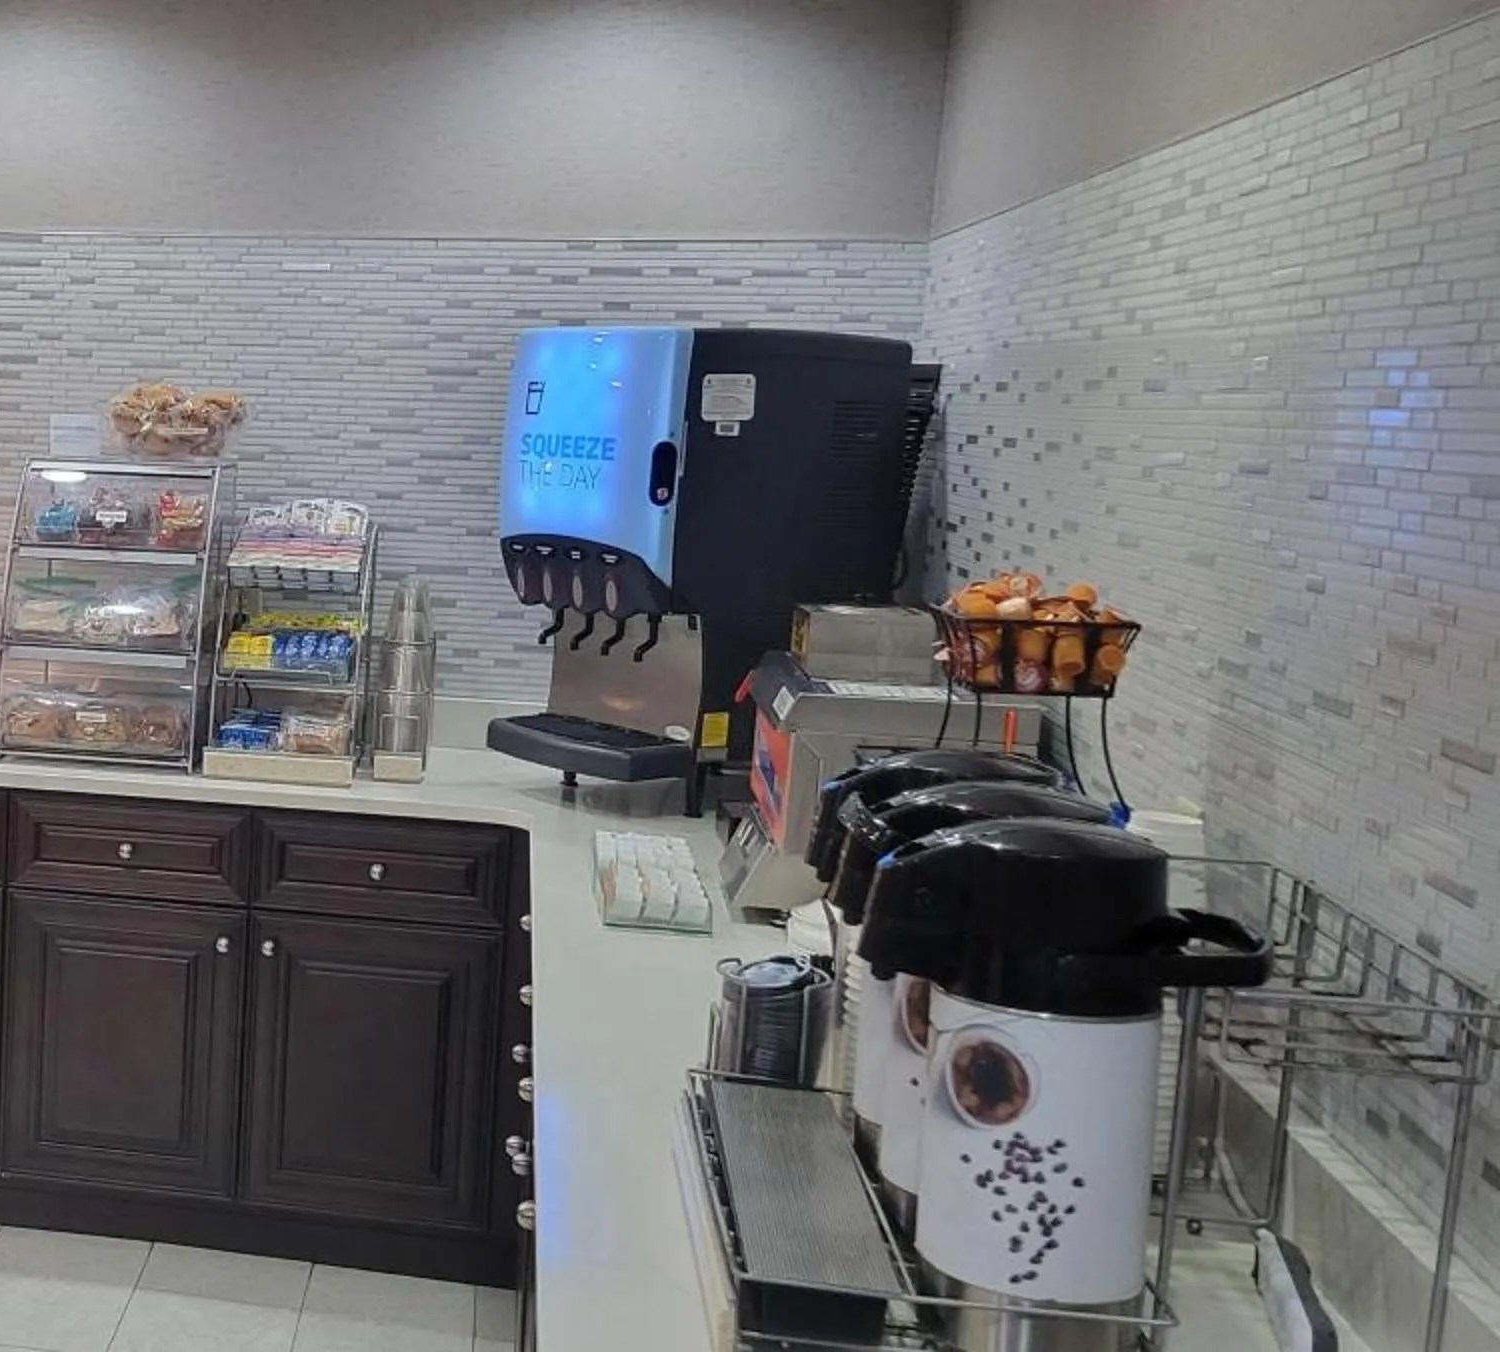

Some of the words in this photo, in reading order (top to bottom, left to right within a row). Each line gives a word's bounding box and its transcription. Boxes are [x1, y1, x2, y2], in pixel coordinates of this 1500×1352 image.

[520, 433, 616, 460] SQUEEZE
[518, 460, 552, 487] THE
[561, 463, 601, 489] DAY
